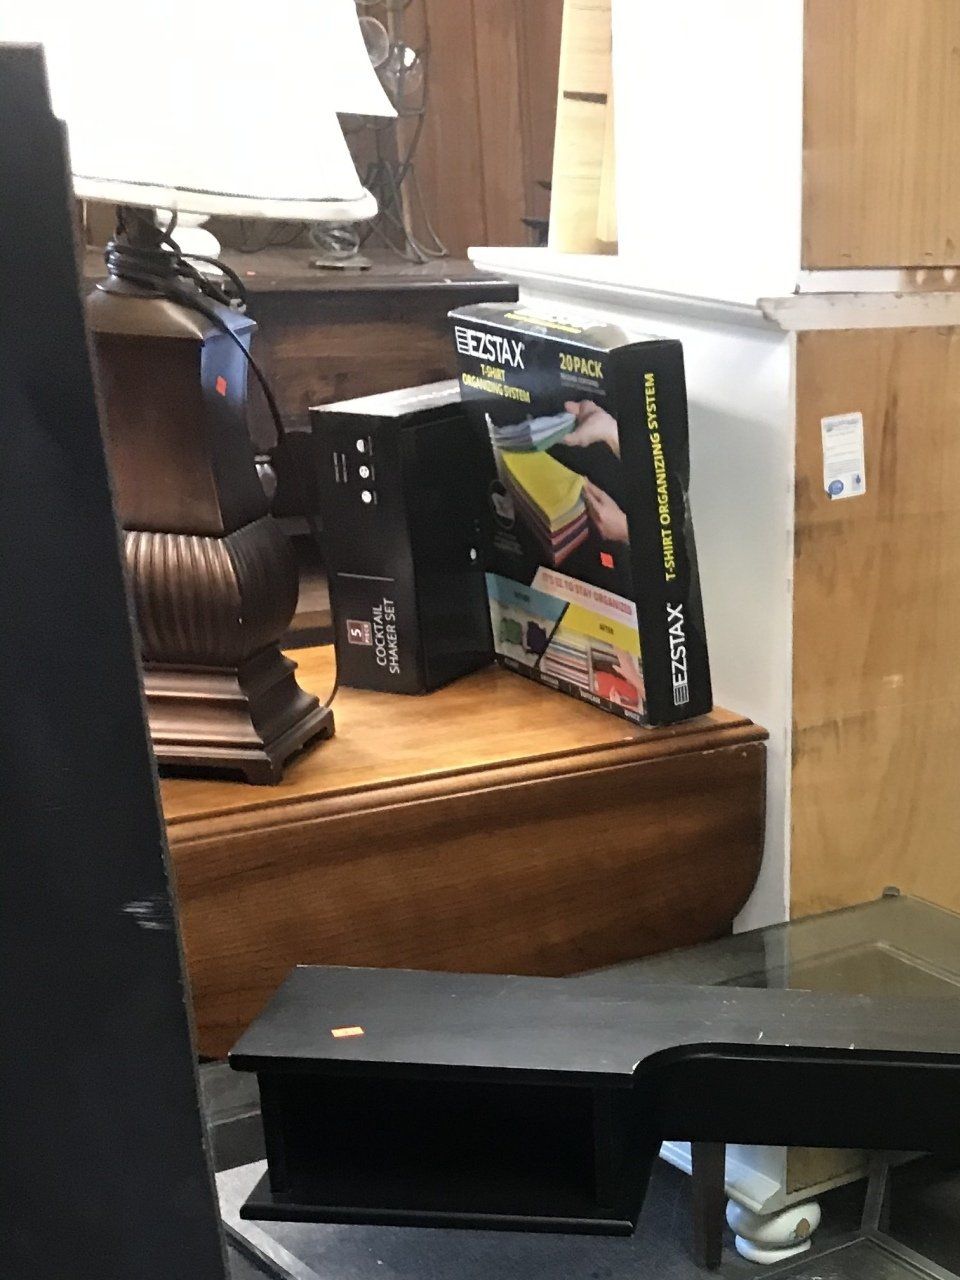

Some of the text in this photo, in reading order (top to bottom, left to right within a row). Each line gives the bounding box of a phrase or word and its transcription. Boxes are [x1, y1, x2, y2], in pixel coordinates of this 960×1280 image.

[644, 373, 677, 581] T-SHIRT ORGANIZING SYSTEM
[351, 628, 362, 637] 5
[373, 604, 387, 666] COCKTAIL
[382, 597, 400, 674] SHAKER SET
